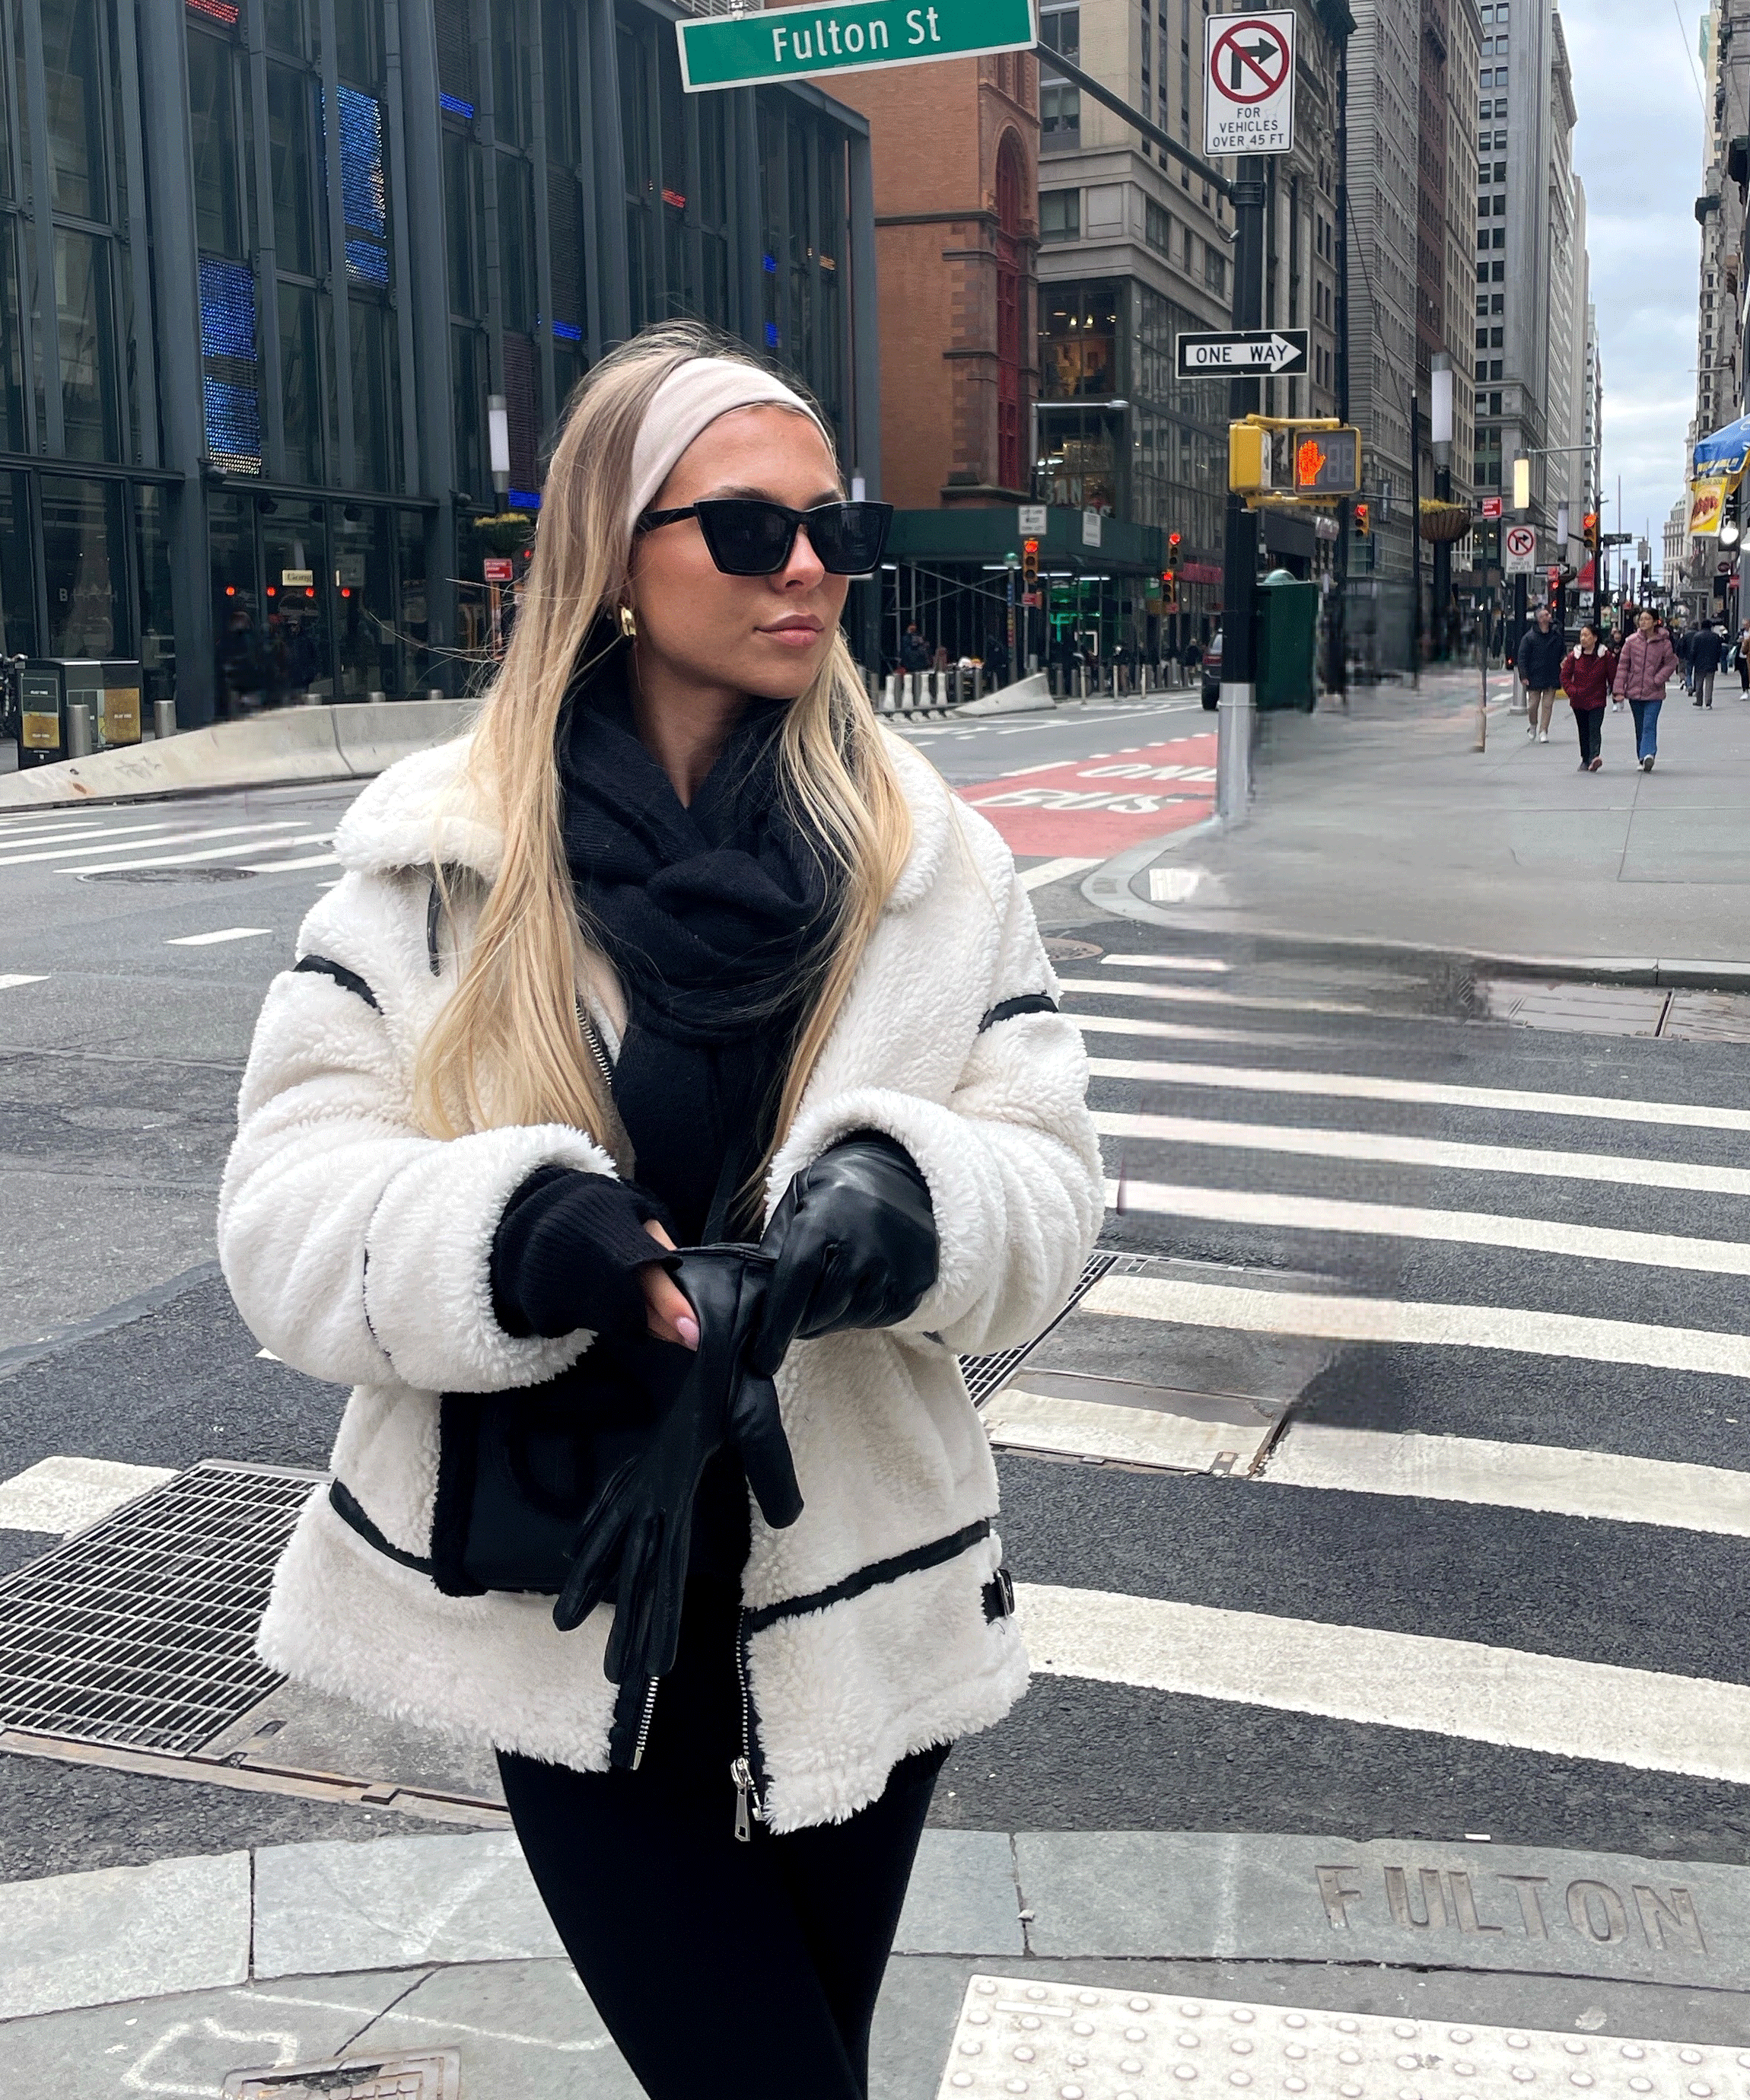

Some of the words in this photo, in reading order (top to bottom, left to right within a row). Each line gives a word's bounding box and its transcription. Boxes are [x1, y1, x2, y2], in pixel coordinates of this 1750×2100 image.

[772, 20, 889, 62] Fulton
[905, 6, 941, 45] St
[1236, 107, 1261, 119] FOR
[1219, 119, 1278, 133] VEHICLES
[1212, 135, 1245, 148] OVER
[1249, 134, 1265, 145] 45
[1269, 133, 1284, 145] FT
[1196, 346, 1232, 364] ONE
[1250, 345, 1288, 362] WAY
[1076, 763, 1217, 782] ONL
[969, 788, 1184, 814] BUS
[1313, 1864, 1709, 1955] FULTON
